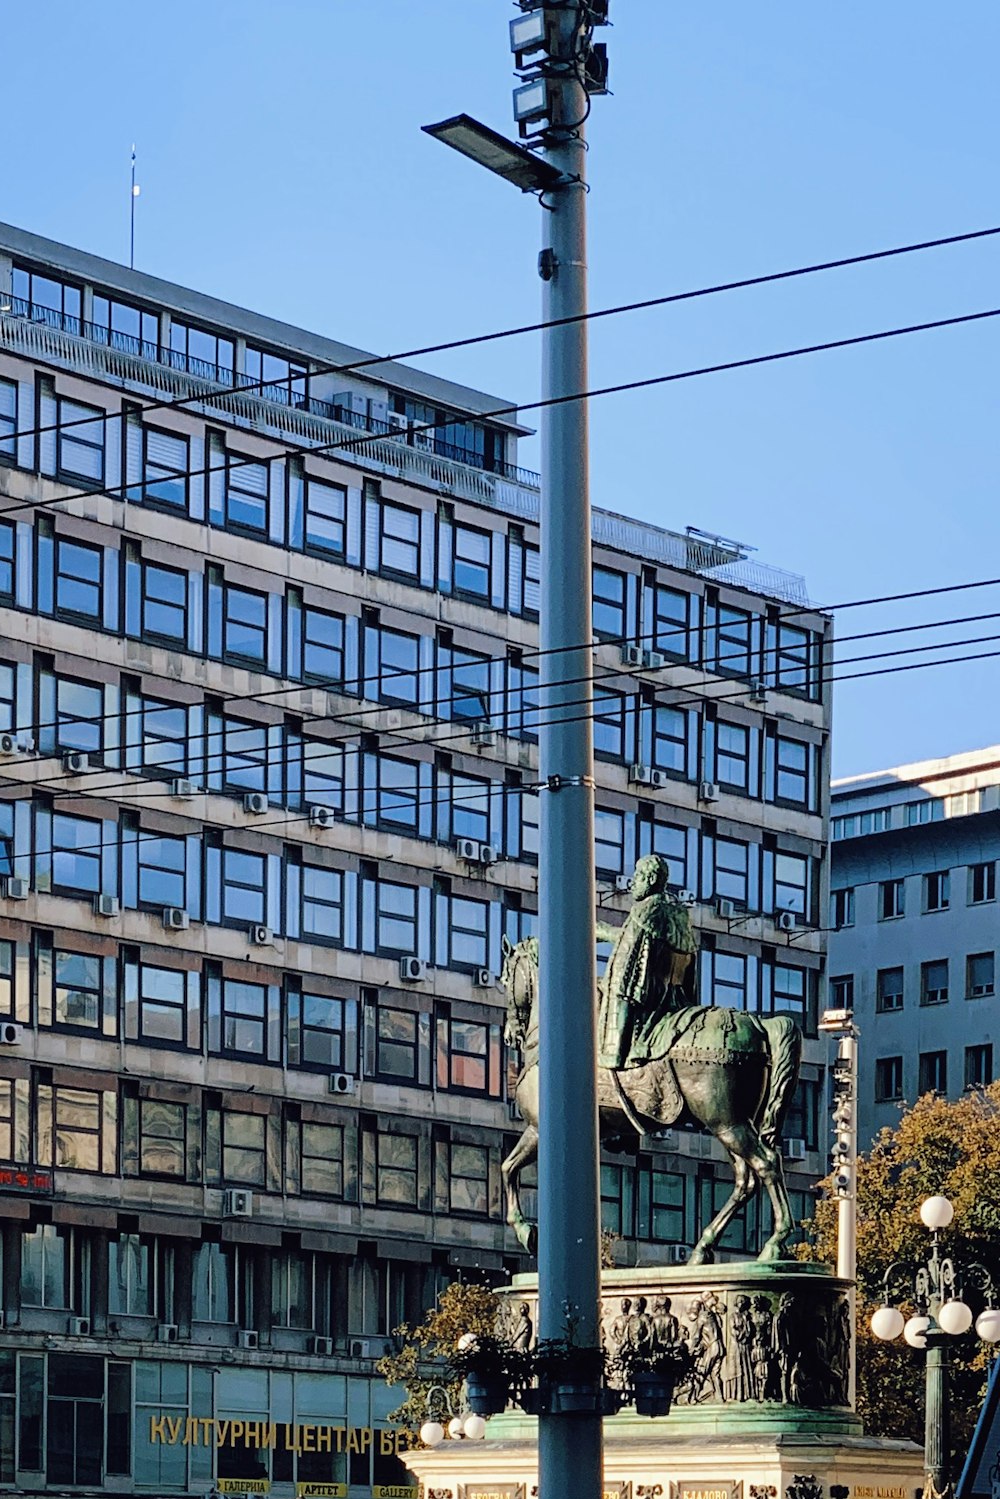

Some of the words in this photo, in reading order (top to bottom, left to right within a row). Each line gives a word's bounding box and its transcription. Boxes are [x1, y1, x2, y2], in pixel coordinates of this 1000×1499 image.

[150, 1415, 276, 1449] КУЛТУРНИ
[285, 1424, 373, 1457] ЦЕНТАР
[224, 1481, 265, 1492] ГАЛЕРИЈА
[305, 1485, 338, 1495] АРТГЕТ
[380, 1487, 414, 1498] GALLERY
